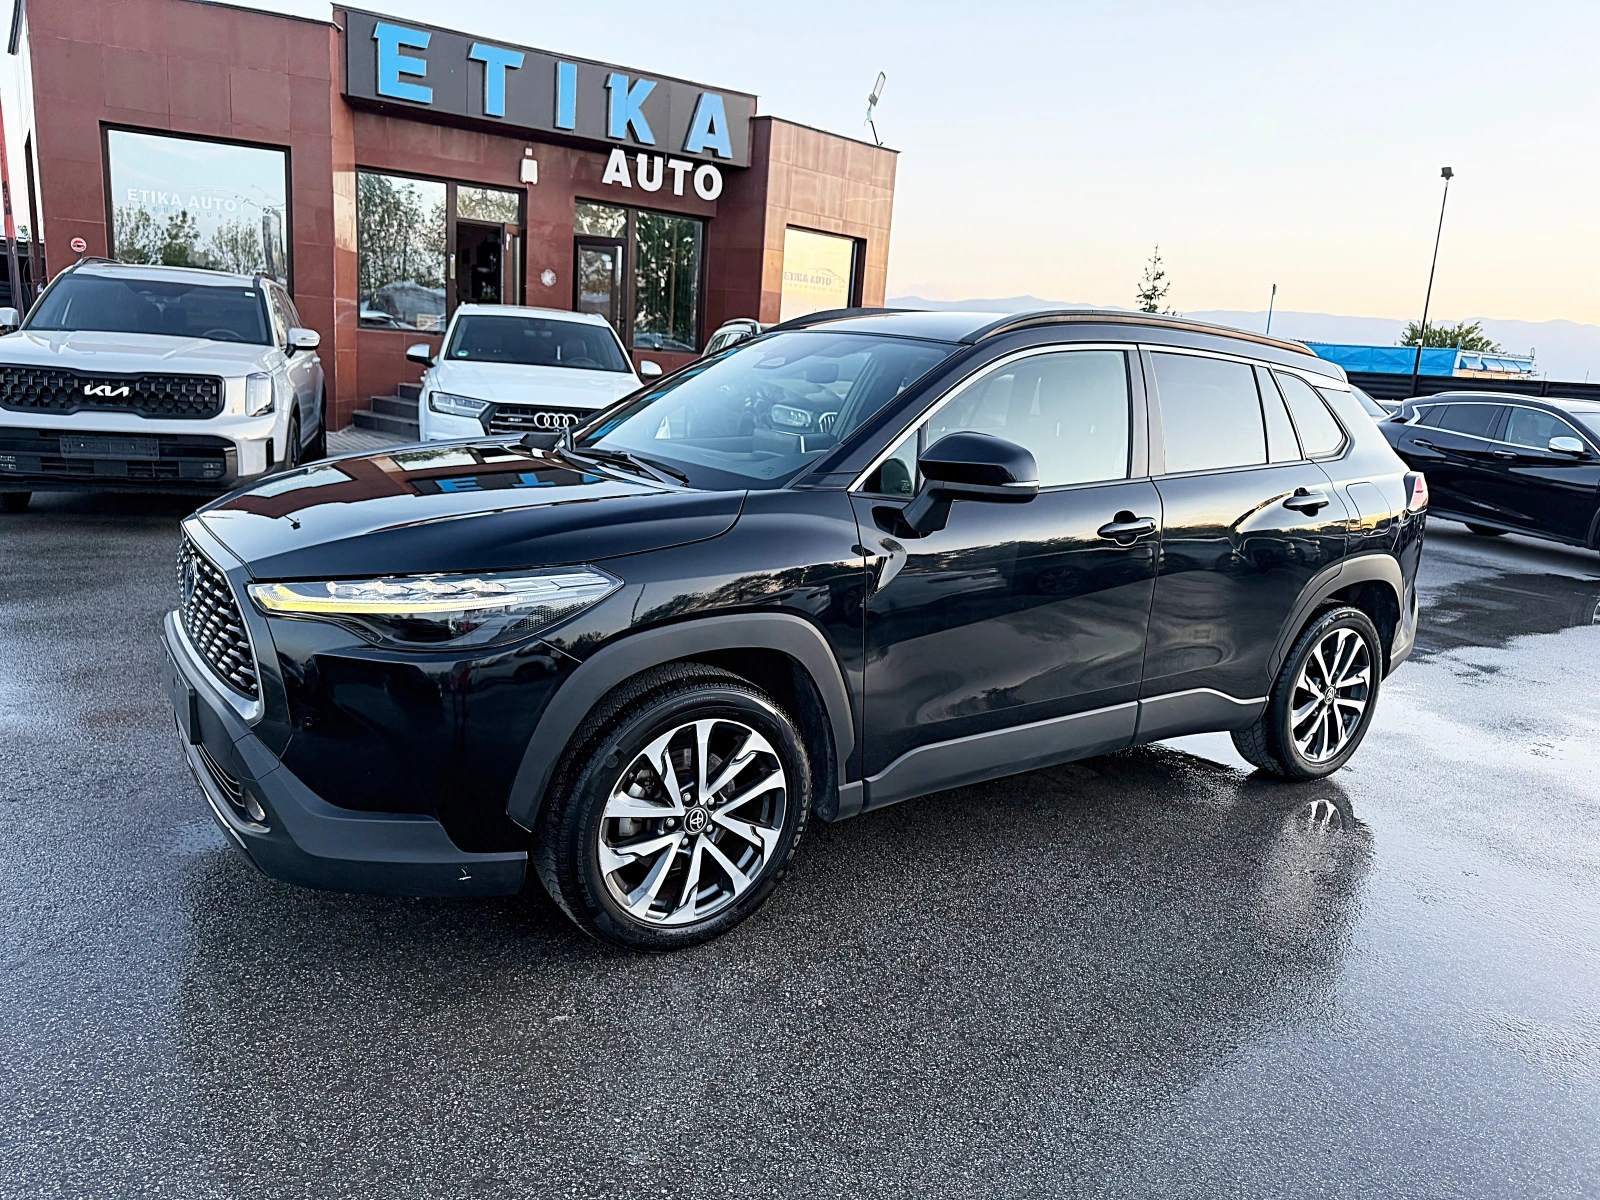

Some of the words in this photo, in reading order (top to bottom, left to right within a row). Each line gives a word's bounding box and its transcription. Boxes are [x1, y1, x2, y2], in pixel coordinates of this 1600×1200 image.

[373, 21, 734, 159] ETIKA
[602, 148, 723, 201] AUTO
[126, 187, 183, 206] ETIKA
[187, 195, 237, 213] AUTO
[784, 271, 808, 283] ETIKA
[810, 275, 832, 286] AUTO
